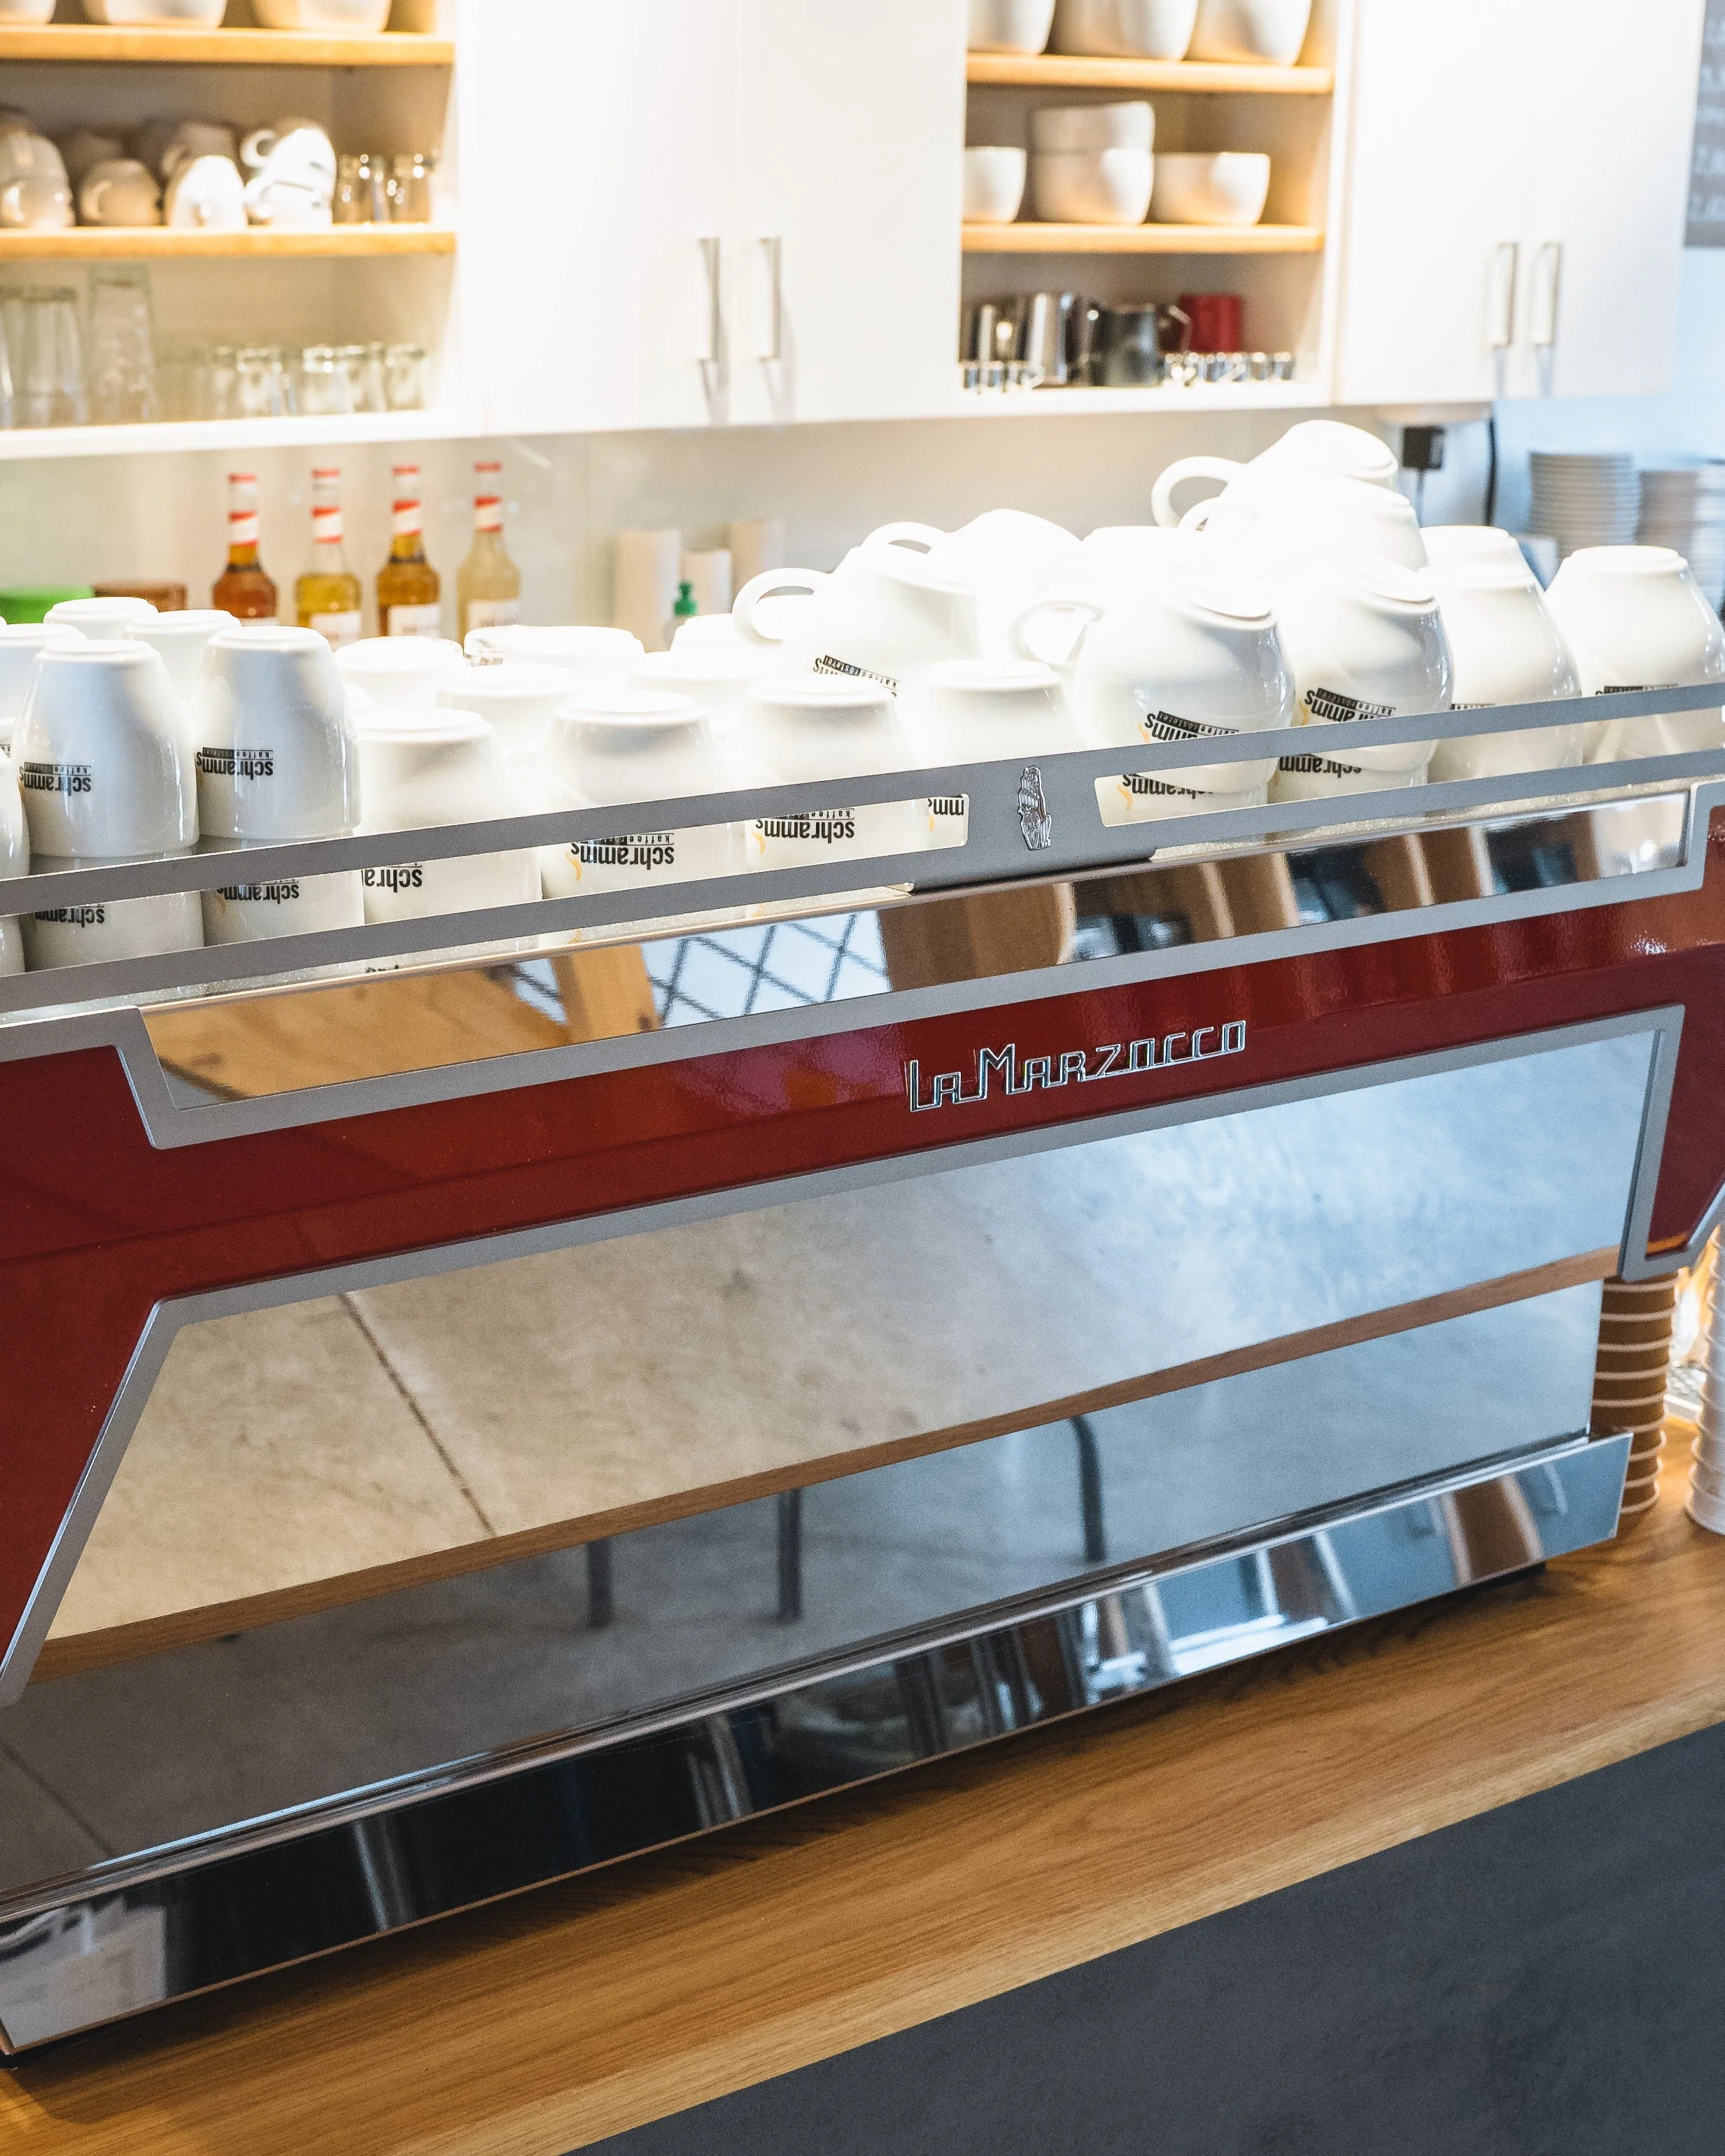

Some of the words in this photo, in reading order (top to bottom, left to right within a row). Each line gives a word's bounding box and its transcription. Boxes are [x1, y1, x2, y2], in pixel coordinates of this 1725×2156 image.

[196, 752, 274, 781] schramms
[19, 766, 92, 796] schramms
[362, 869, 423, 893] schra
[35, 908, 105, 929] schramm
